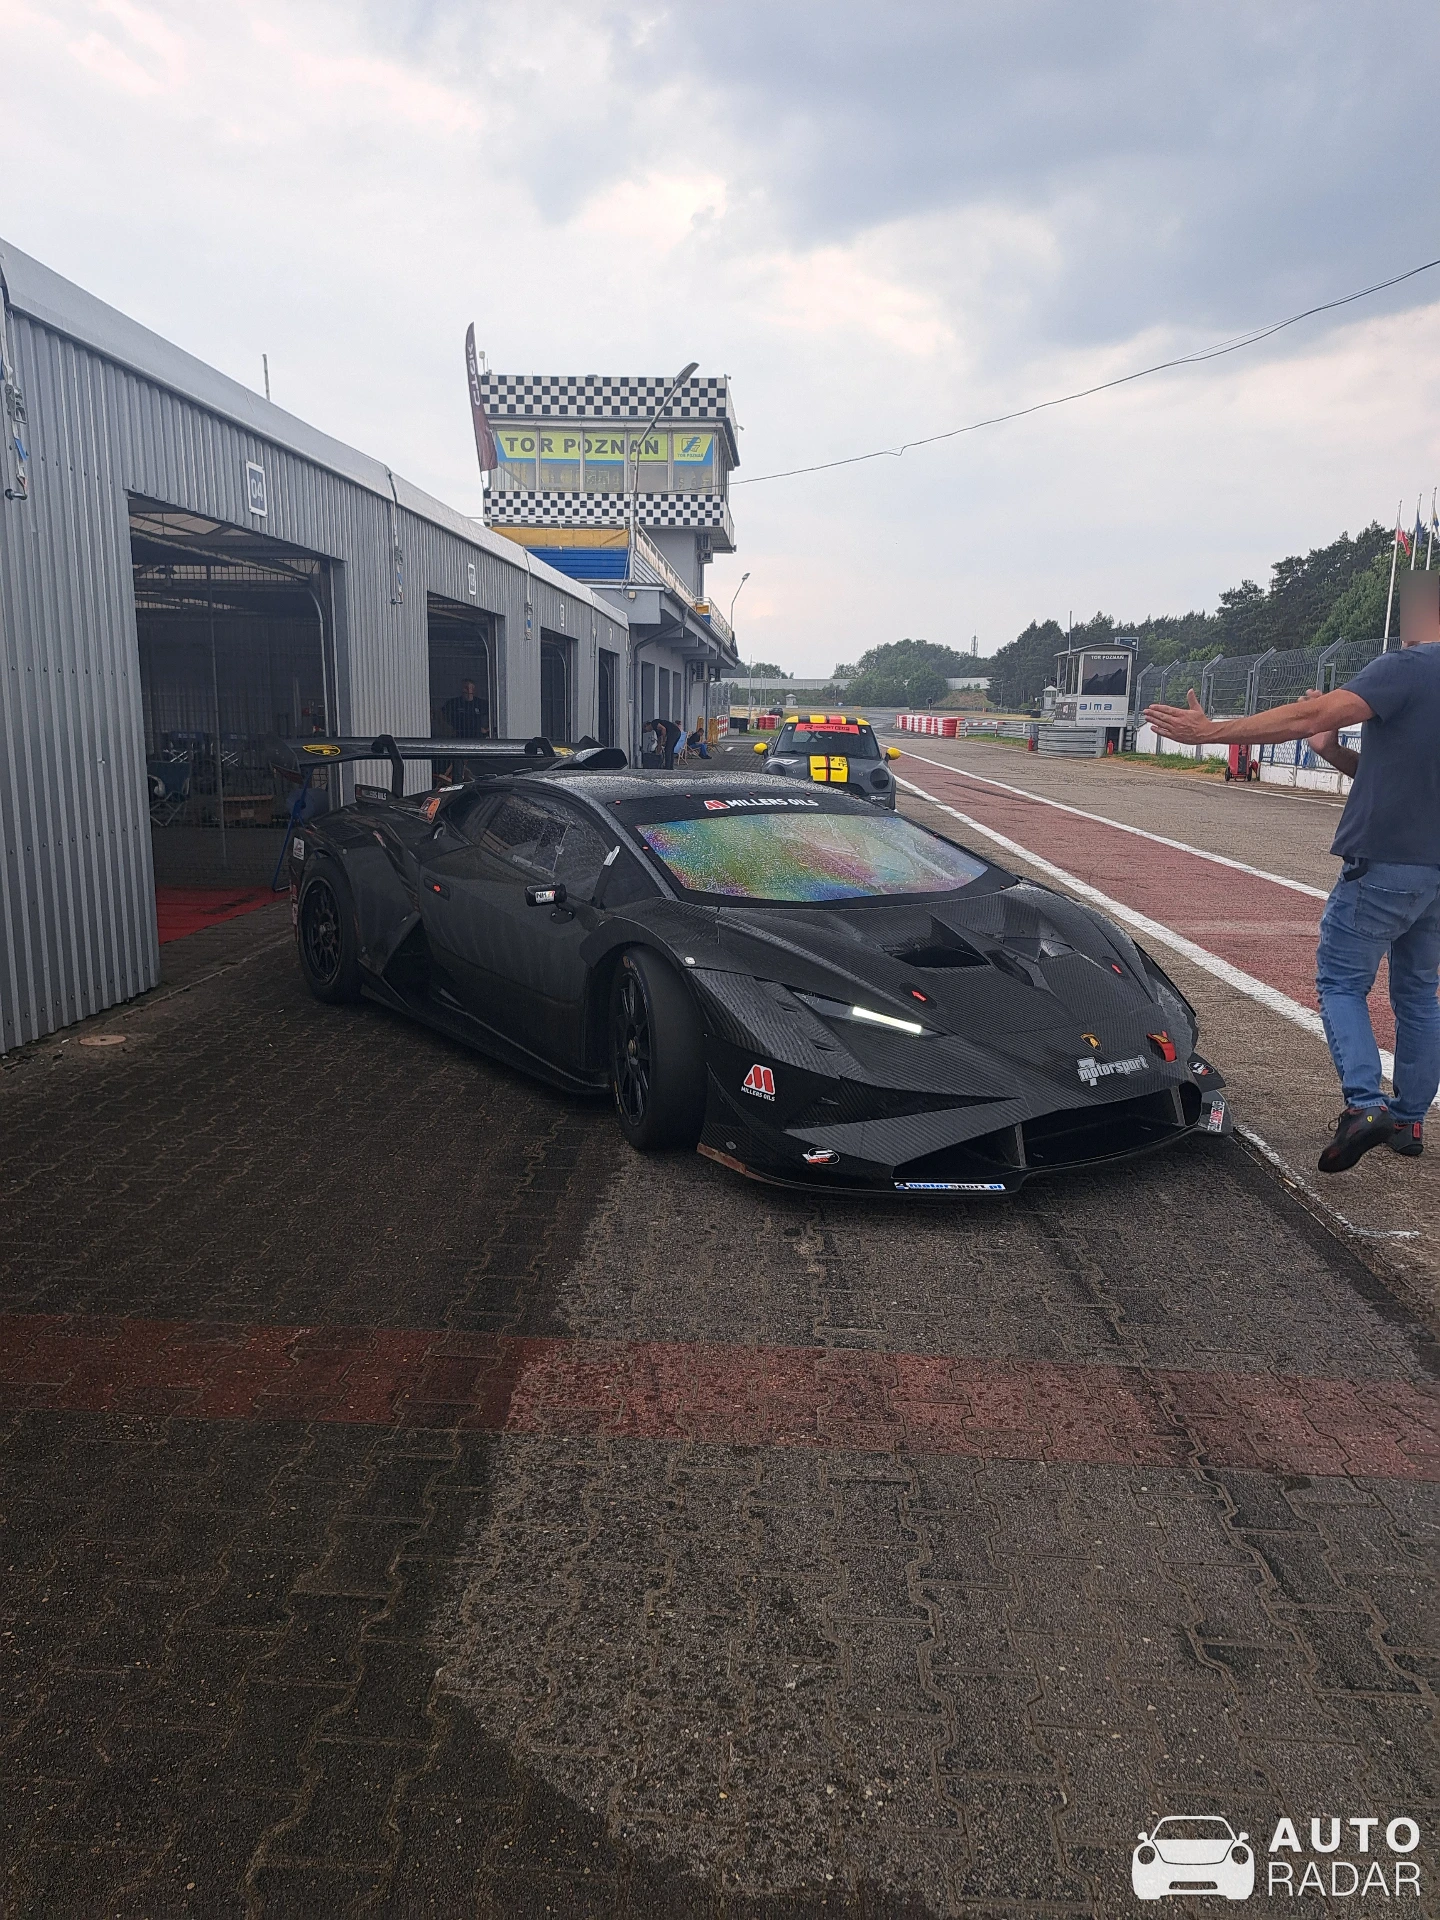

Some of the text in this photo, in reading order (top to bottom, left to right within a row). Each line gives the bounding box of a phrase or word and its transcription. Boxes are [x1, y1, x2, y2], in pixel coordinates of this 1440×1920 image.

[505, 436, 659, 455] TOR POZNAŃ
[250, 478, 264, 502] 04
[1079, 702, 1113, 711] alma
[725, 798, 819, 807] MILLERS OILS
[741, 1086, 776, 1102] MILLERS OILS
